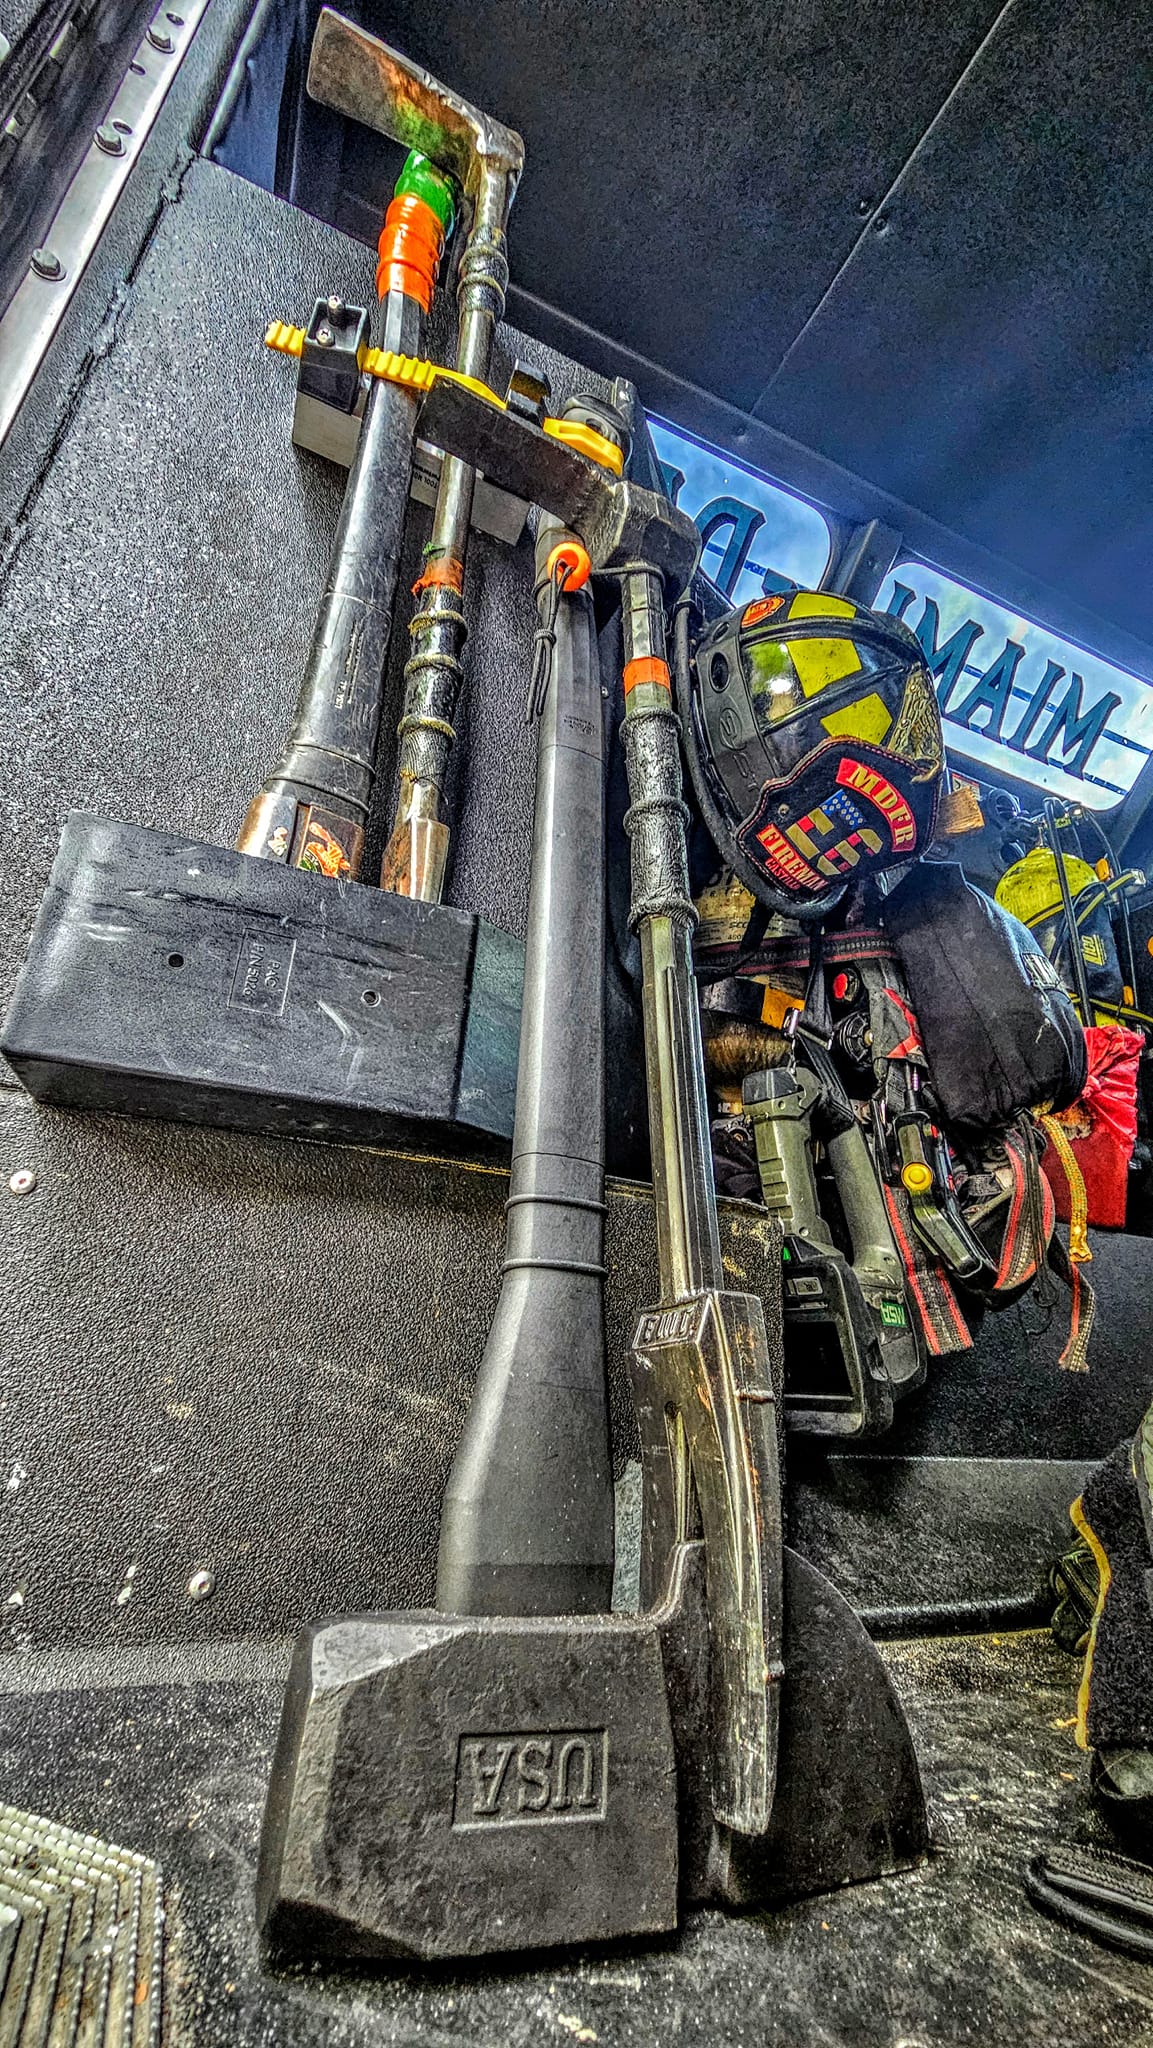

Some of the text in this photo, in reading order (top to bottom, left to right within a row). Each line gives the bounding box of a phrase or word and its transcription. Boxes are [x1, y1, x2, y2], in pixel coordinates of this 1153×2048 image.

[785, 789, 883, 876] 26
[847, 763, 914, 845] MDFR
[760, 826, 829, 891] FIREMAN
[265, 959, 281, 988] PAC
[881, 1302, 906, 1326] MSA
[464, 1737, 598, 1815] USA
